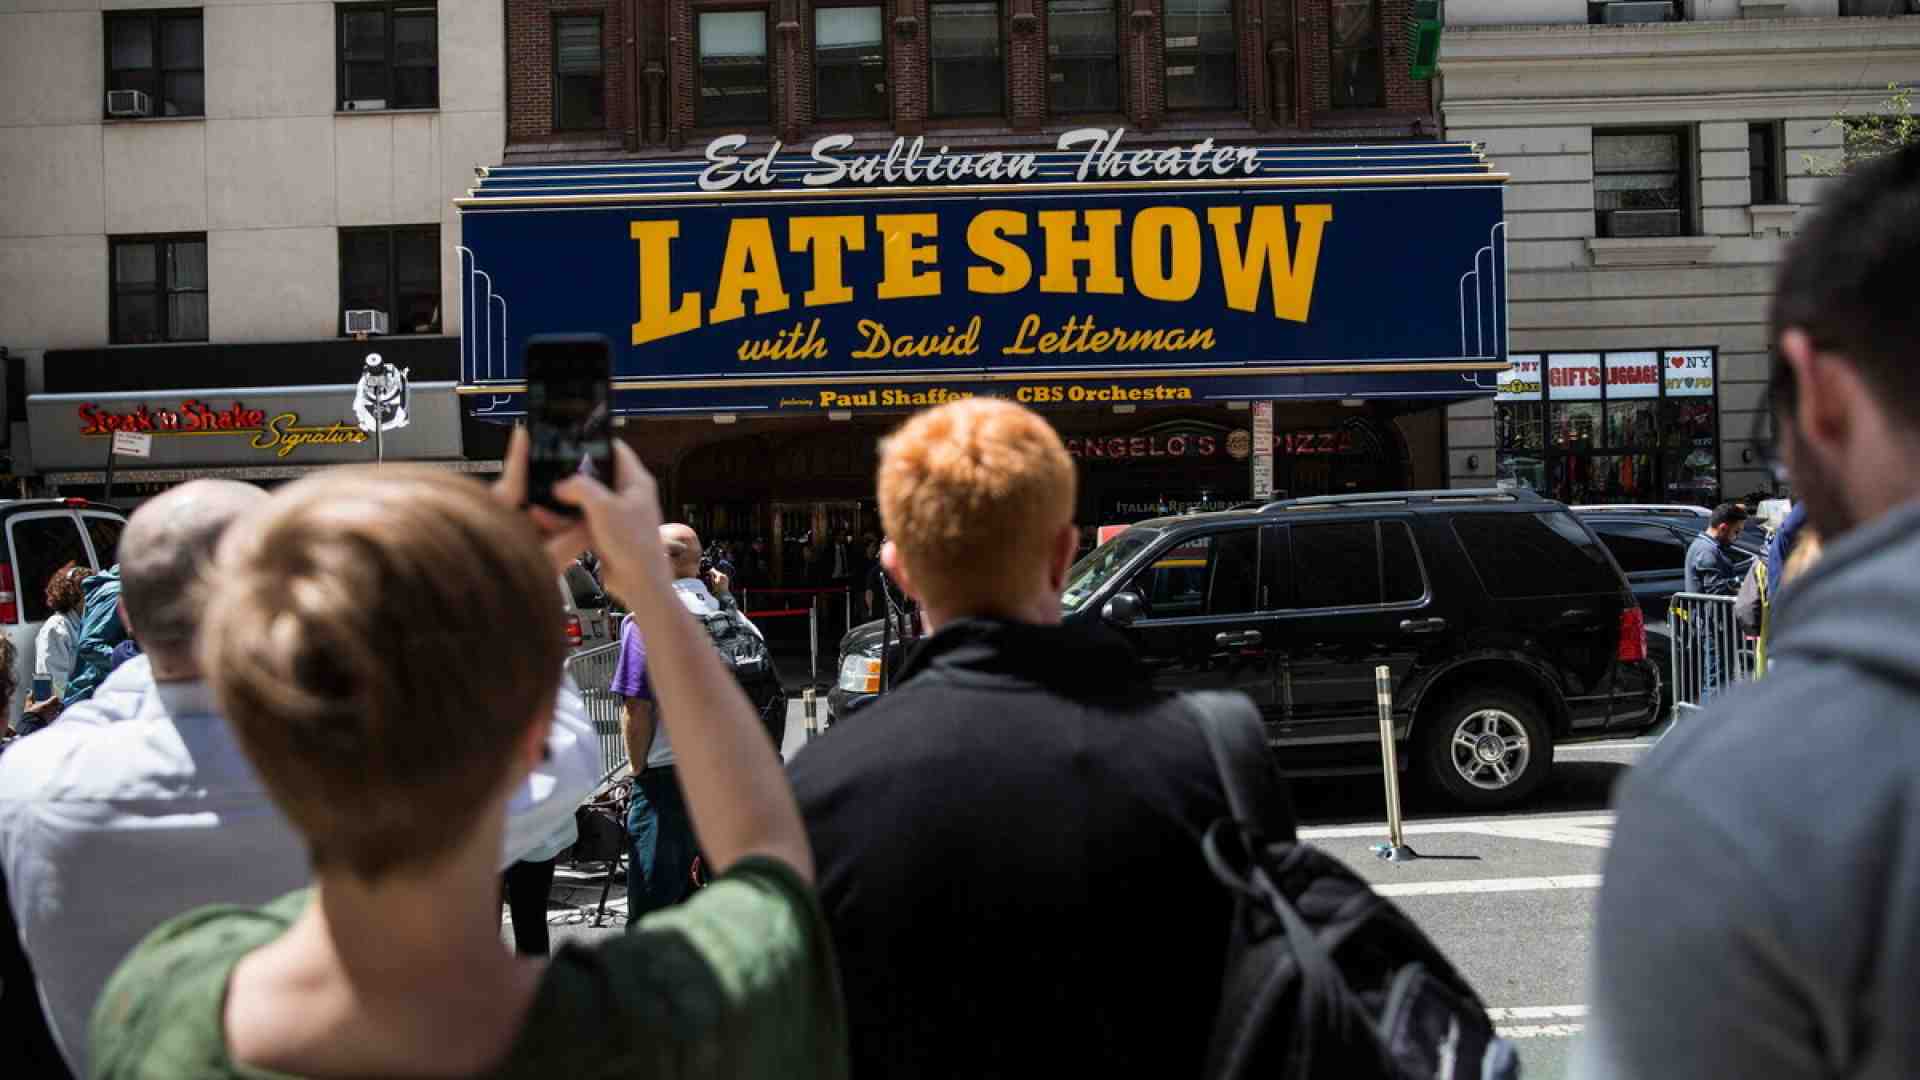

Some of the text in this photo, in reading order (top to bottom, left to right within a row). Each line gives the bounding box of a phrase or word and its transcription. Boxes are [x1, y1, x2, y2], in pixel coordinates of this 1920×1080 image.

[698, 127, 1262, 191] Ed Sullivan Theater
[630, 204, 1333, 346] LATE SHOW
[737, 313, 1216, 361] with David Letterman
[1549, 366, 1600, 387] GIFTS
[1605, 365, 1659, 385] LUGGAGE
[1685, 356, 1711, 368] NY
[819, 390, 877, 407] Paul
[1016, 386, 1064, 402] CBS
[1068, 384, 1192, 401] Orchestra
[79, 402, 155, 432] Steak
[179, 399, 265, 431] Shake
[252, 413, 368, 457] Signature
[1066, 433, 1216, 458] ANGELO'S
